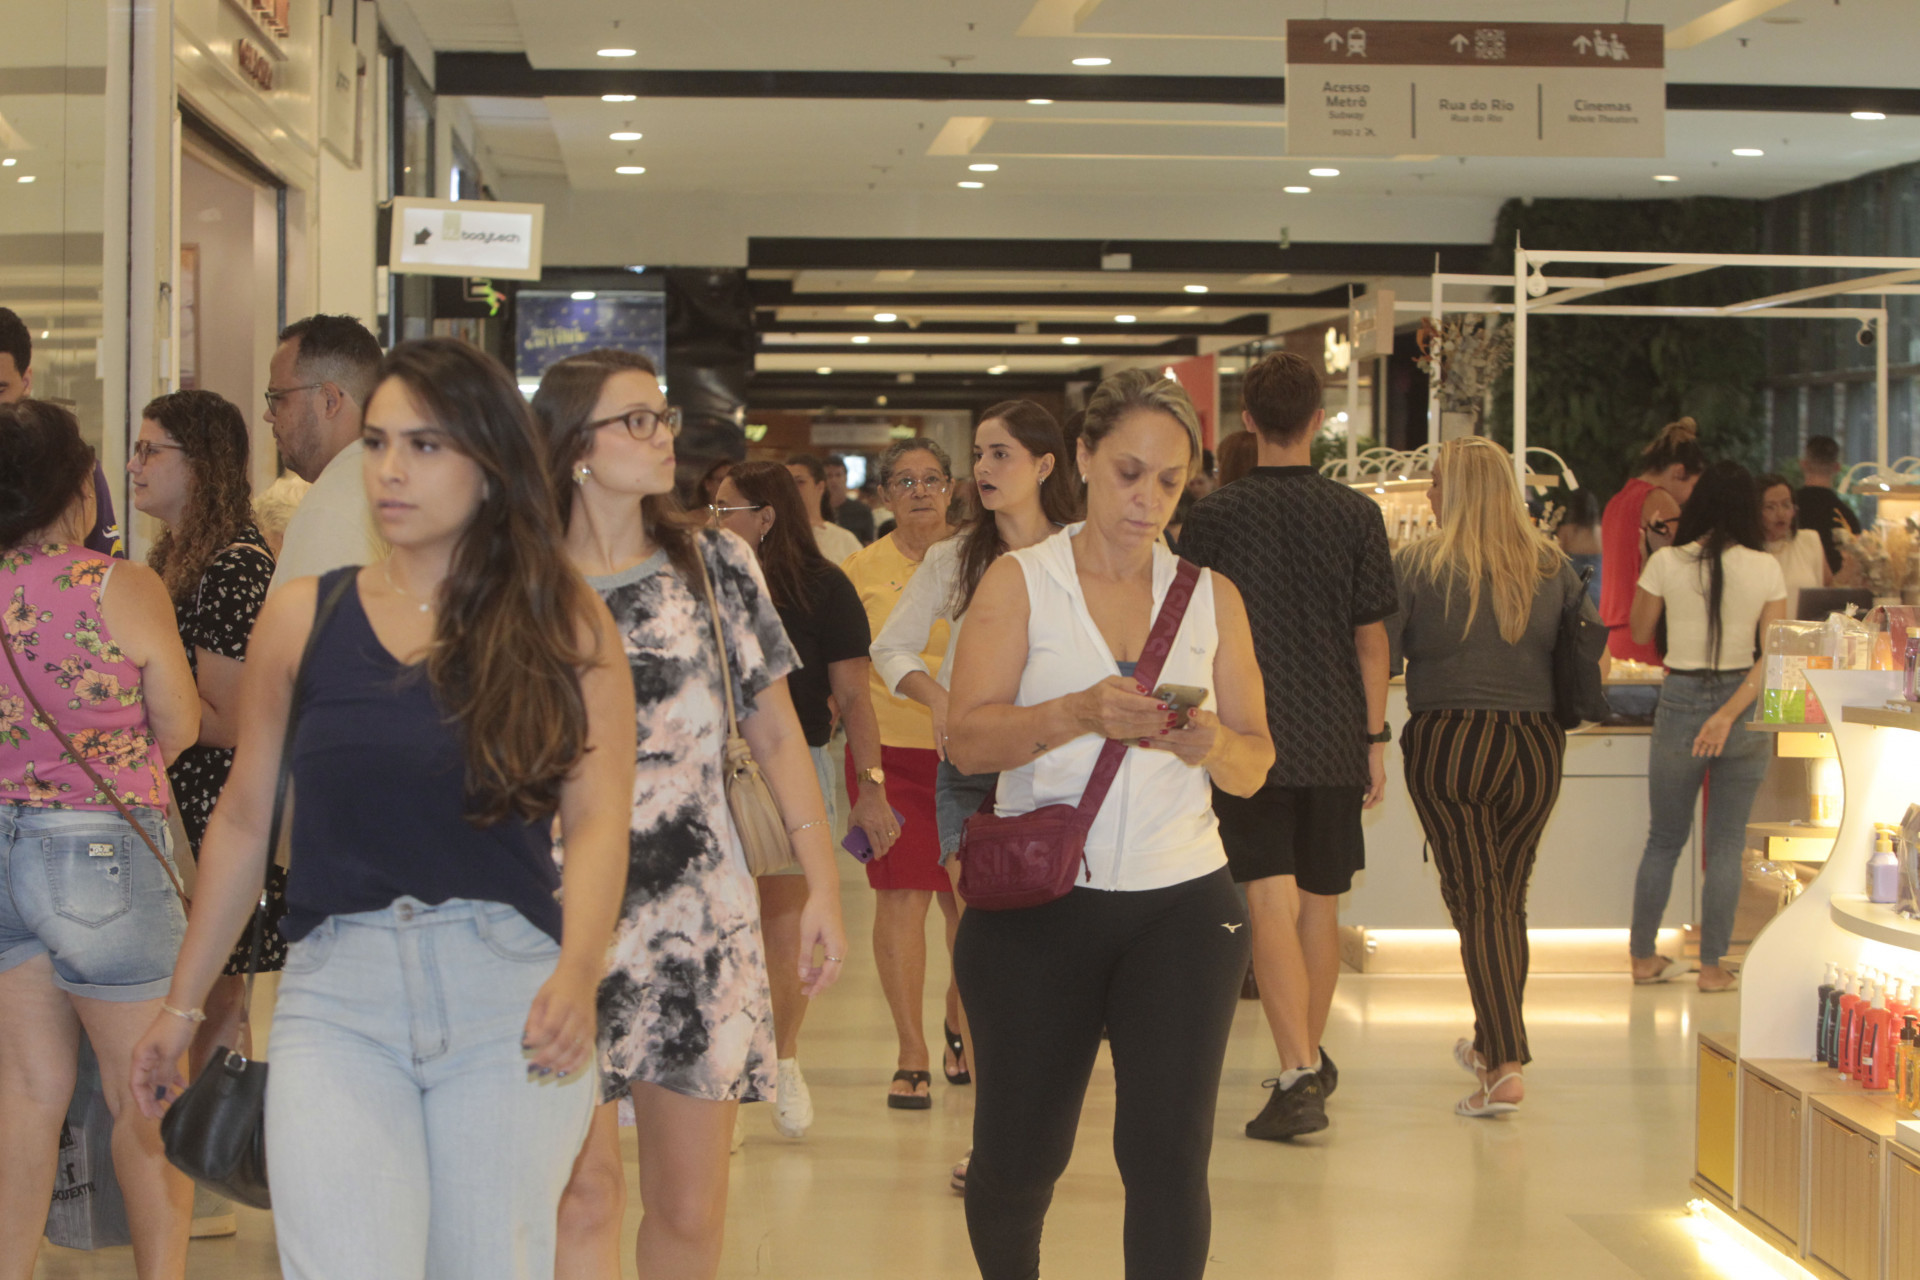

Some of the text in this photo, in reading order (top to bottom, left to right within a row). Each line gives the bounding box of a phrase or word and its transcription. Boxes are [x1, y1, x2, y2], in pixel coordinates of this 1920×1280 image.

[1322, 81, 1371, 93] Acesso
[1325, 95, 1368, 107] Metrô
[1438, 98, 1515, 111] Rua do Rio
[1574, 99, 1632, 111] Cinemas
[1328, 110, 1365, 121] Subway
[1450, 113, 1470, 122] Rua
[1472, 114, 1485, 122] do
[460, 229, 521, 244] bodytech
